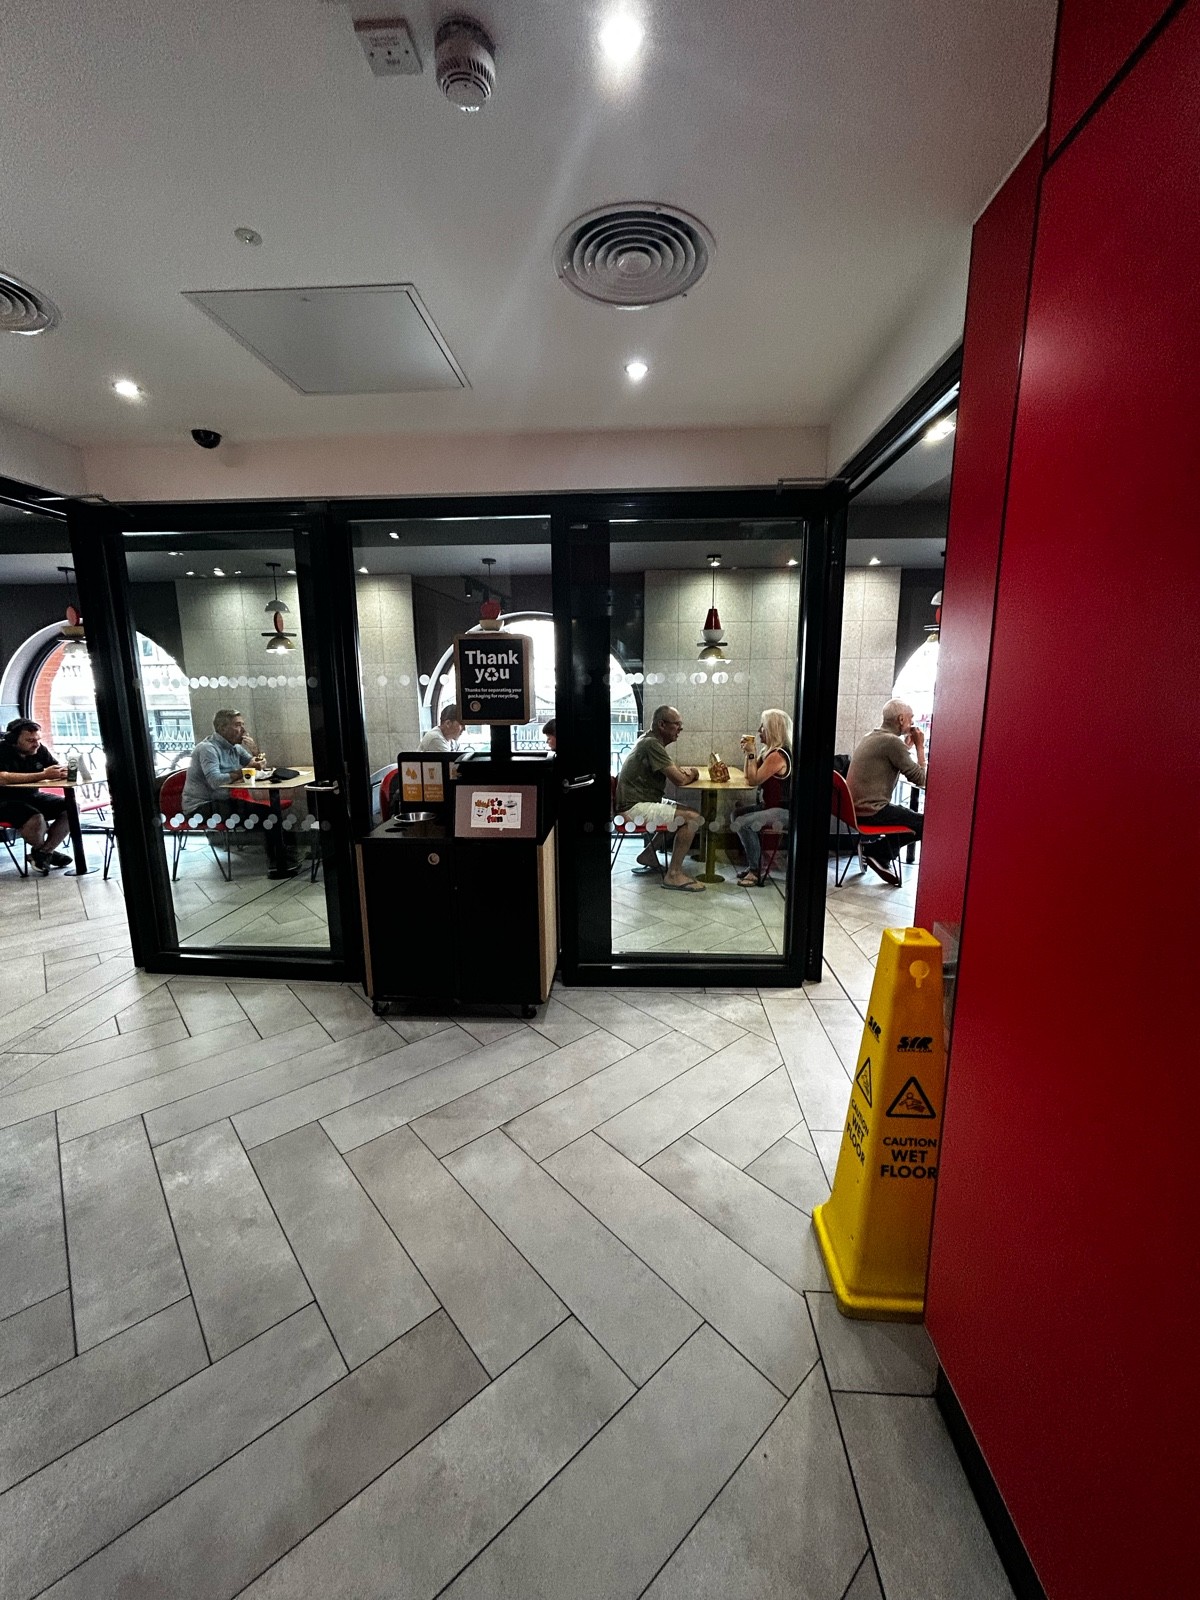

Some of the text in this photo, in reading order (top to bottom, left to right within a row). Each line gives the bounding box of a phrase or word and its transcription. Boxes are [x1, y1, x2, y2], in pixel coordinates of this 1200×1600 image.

[464, 650, 519, 665] Thank
[474, 667, 510, 683] you
[491, 807, 507, 815] bin
[487, 815, 503, 823] fun
[851, 1099, 869, 1136] CAUTION
[852, 1114, 865, 1143] WET
[846, 1122, 866, 1166] FLOOR
[882, 1137, 937, 1147] CAUTION
[891, 1149, 928, 1163] WET
[880, 1165, 938, 1179] FLOOR
